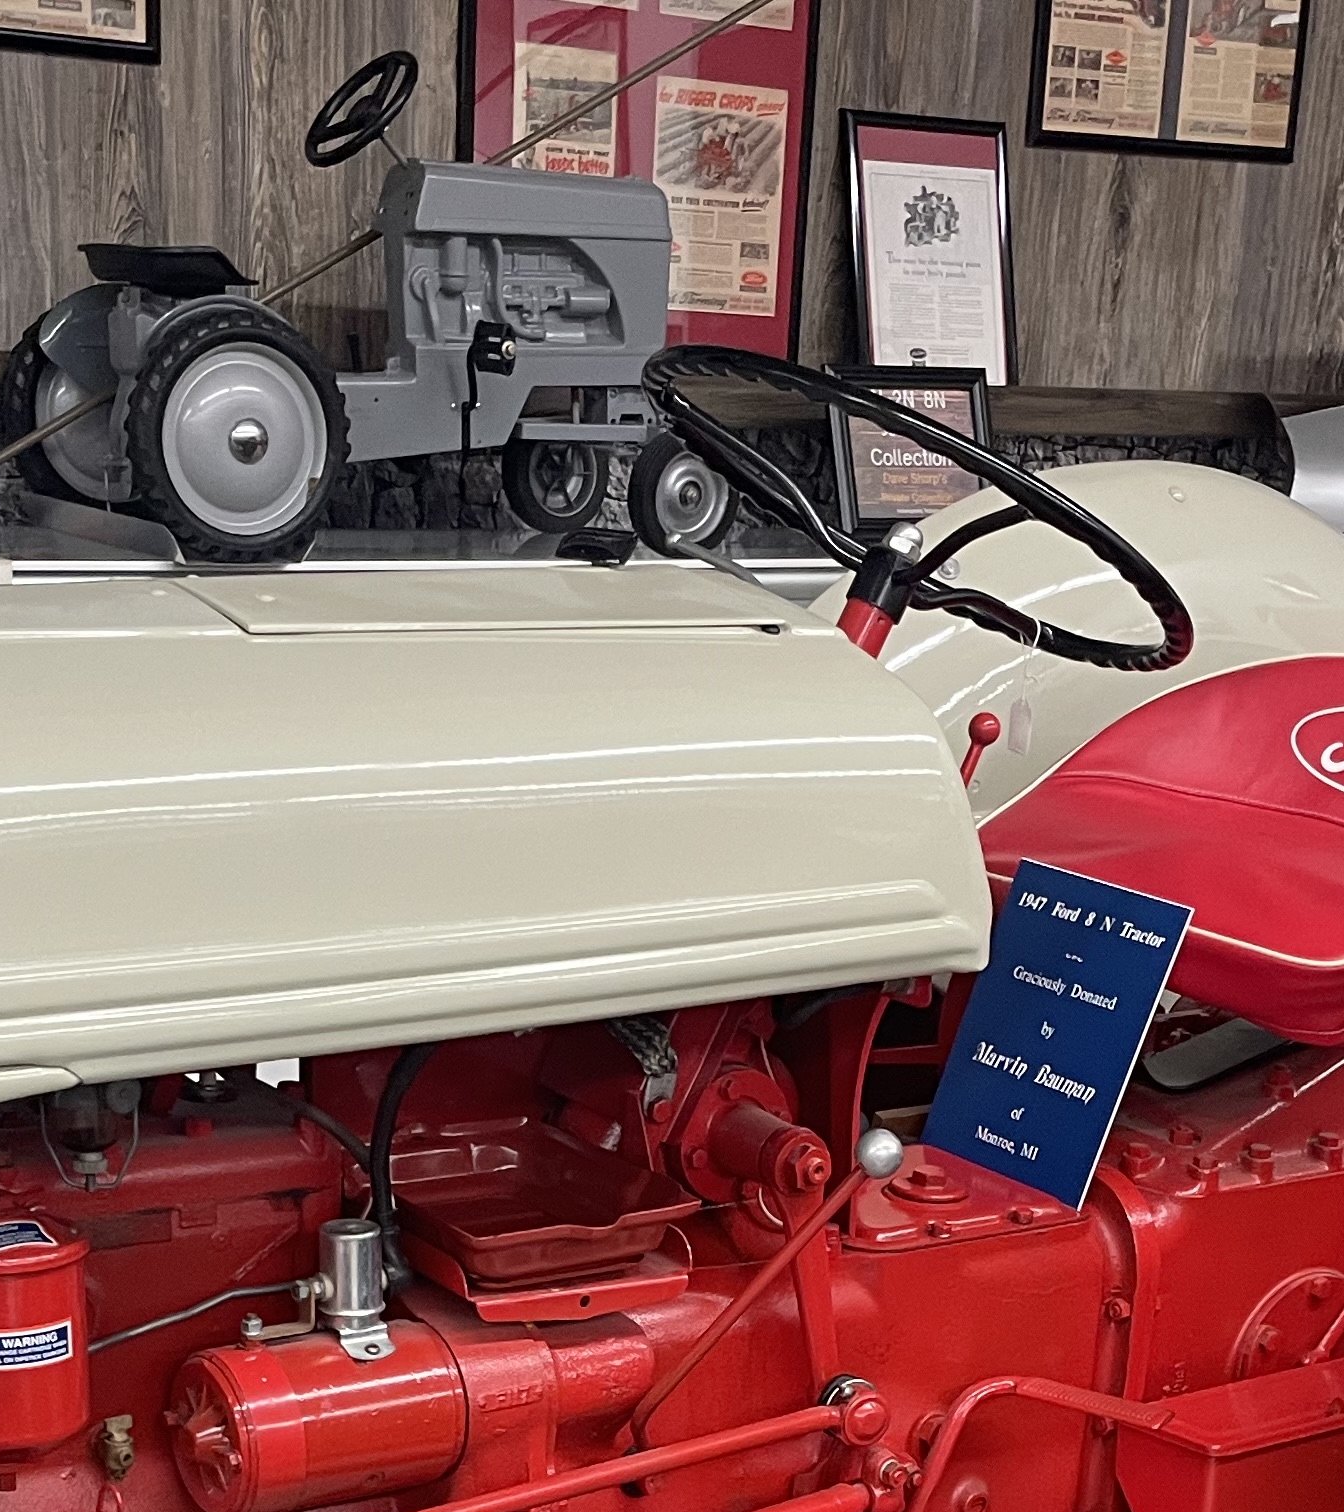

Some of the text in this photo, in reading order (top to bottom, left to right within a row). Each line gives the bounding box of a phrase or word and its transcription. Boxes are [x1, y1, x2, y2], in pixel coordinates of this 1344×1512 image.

[675, 88, 717, 108] BIGGER
[719, 92, 757, 112] CROPS
[923, 390, 946, 409] 8N
[870, 448, 952, 467] Collection
[1018, 892, 1166, 948] 1947 Ford 8 N Tractor
[1013, 965, 1118, 1011] Graciously Donated
[1040, 1020, 1056, 1040] by
[972, 1041, 1096, 1105] Marvin Bauman
[1010, 1107, 1025, 1121] of
[974, 1125, 1039, 1161] Monroe, MI
[1, 1331, 58, 1349] WARNING
